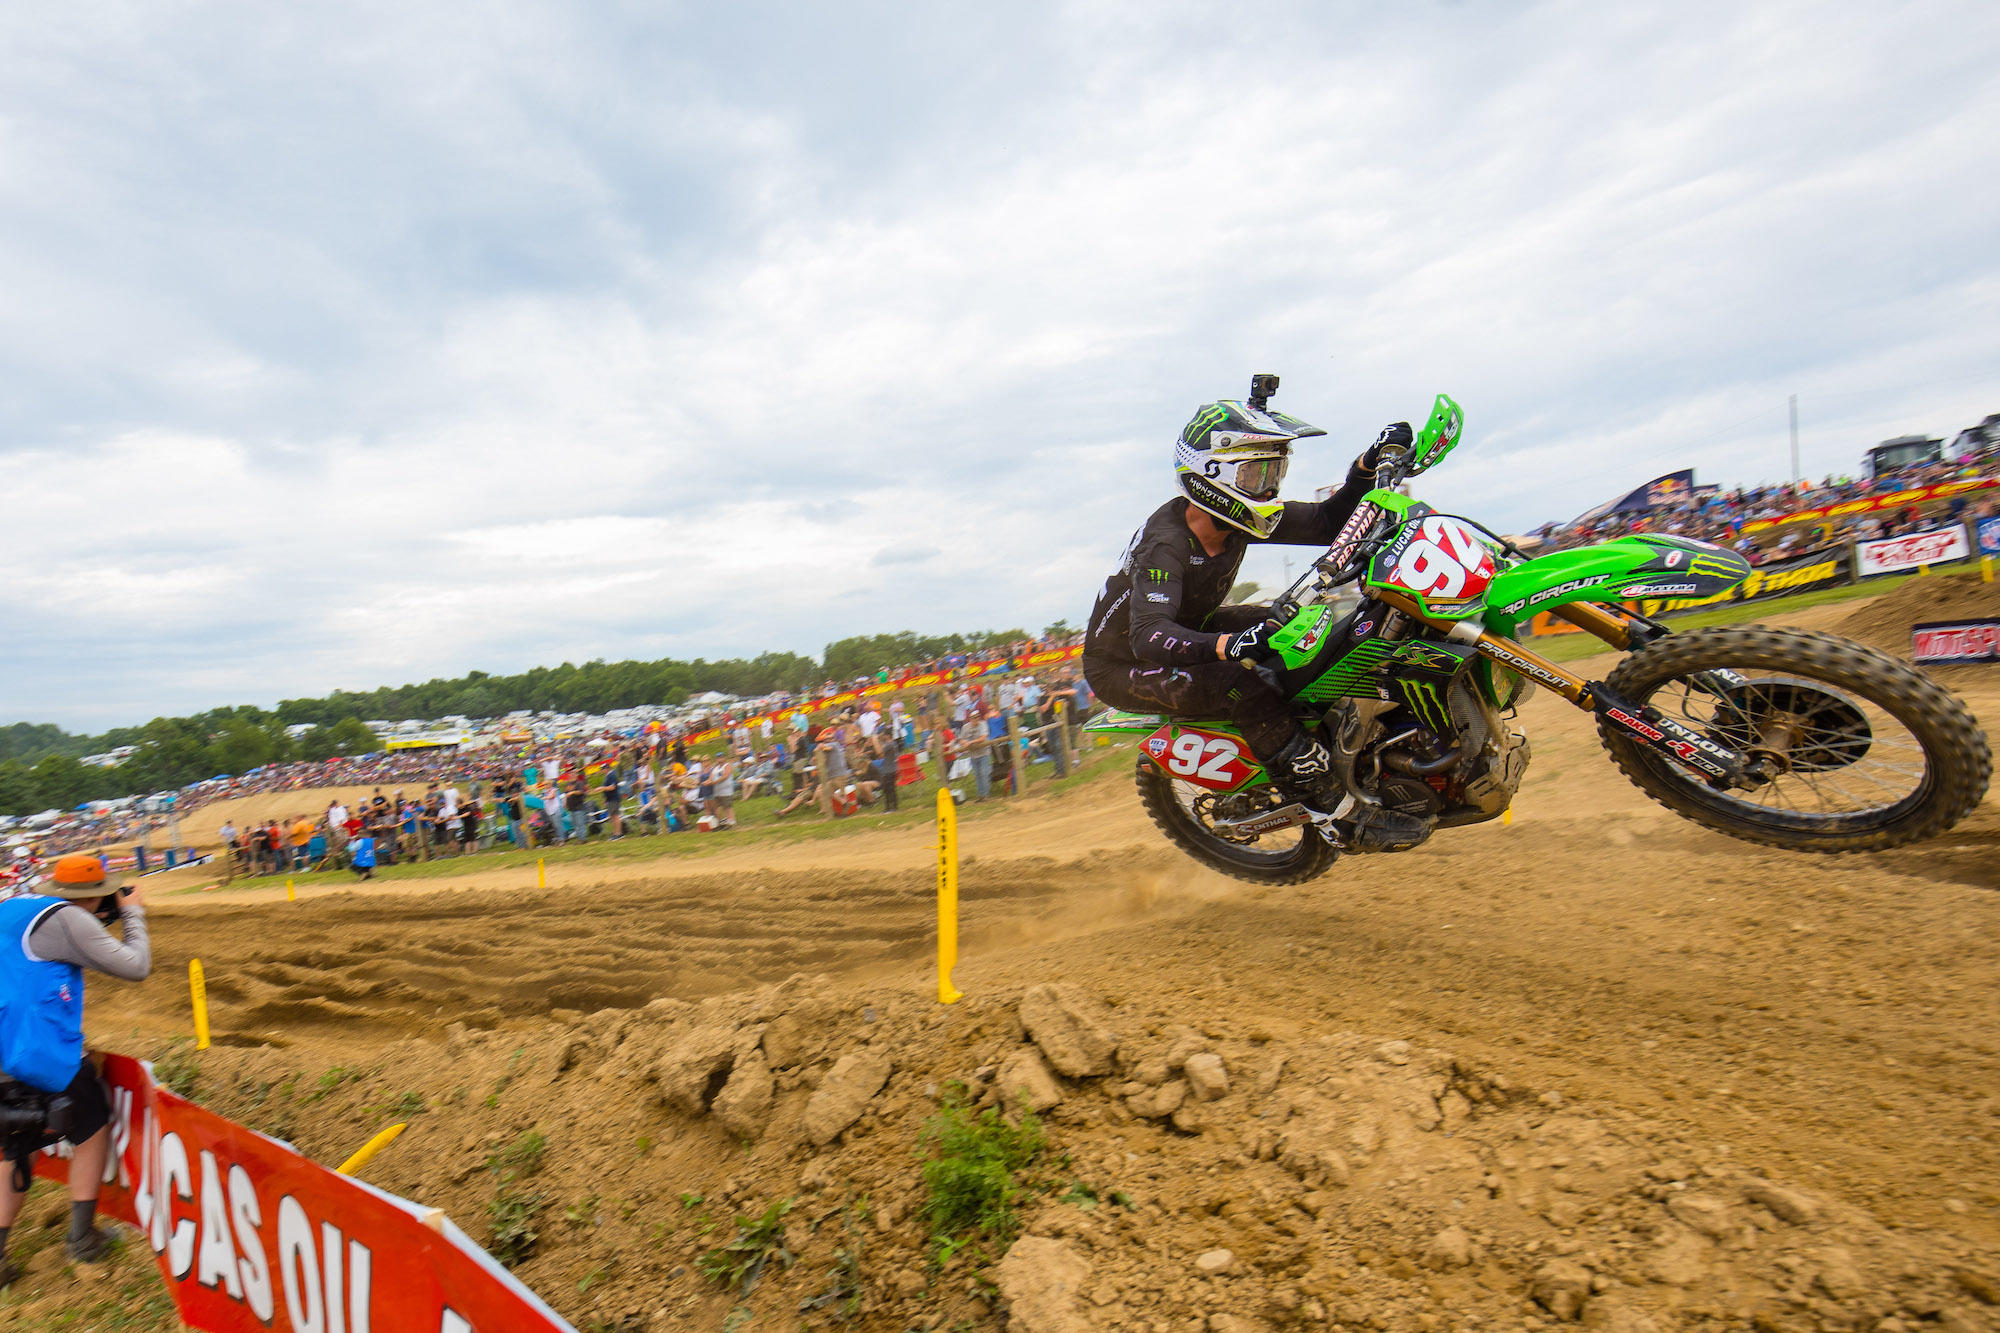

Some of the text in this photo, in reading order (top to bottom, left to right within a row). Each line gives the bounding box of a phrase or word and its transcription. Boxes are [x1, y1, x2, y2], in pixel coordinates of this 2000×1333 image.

[1189, 477, 1230, 507] MONSTER
[1391, 525, 1415, 556] LUCAS
[1398, 516, 1485, 598] 92
[1529, 574, 1612, 606] CIRCUIT
[1149, 631, 1193, 655] FOX
[1477, 641, 1573, 690] PRO CIRCUIT
[1607, 708, 1664, 741] BRAKING
[1658, 718, 1736, 760] UNLOP
[1168, 733, 1240, 783] 92
[134, 1106, 275, 1326] LUCAS
